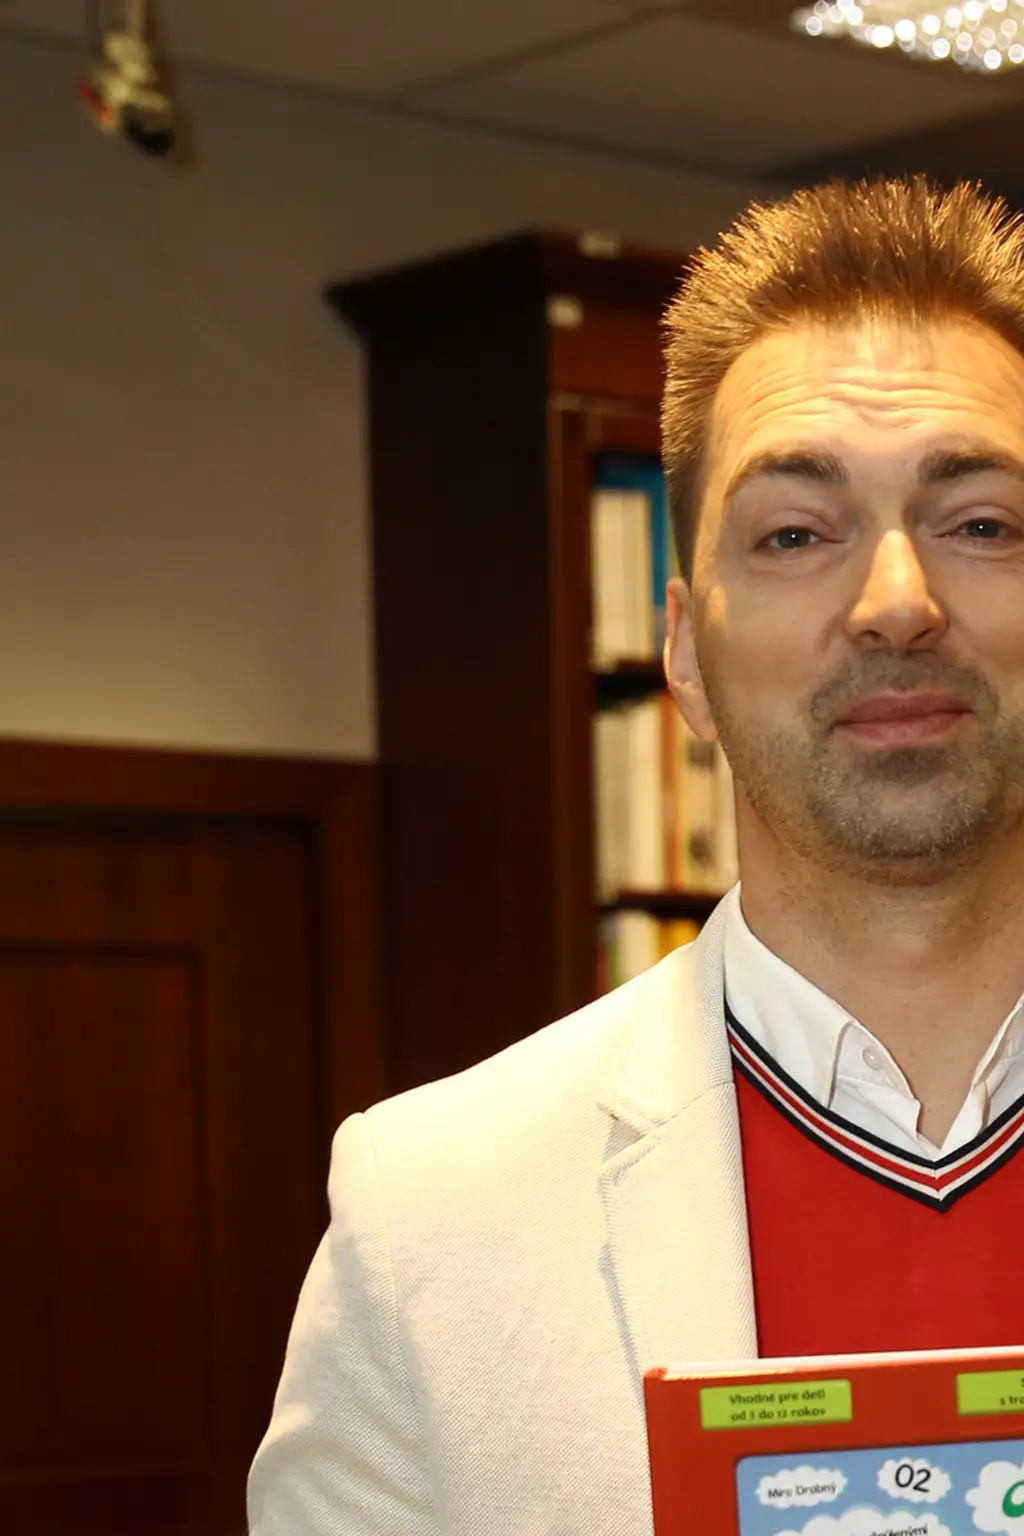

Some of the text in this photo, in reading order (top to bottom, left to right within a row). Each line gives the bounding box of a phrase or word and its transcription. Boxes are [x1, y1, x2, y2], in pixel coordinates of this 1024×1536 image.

[779, 1391, 799, 1404] pre
[802, 1389, 826, 1400] deti
[730, 1409, 746, 1421] od
[758, 1408, 774, 1419] do
[790, 1406, 827, 1417] rokov
[894, 1463, 932, 1493] 02
[767, 1481, 837, 1499] Miro Drobný
